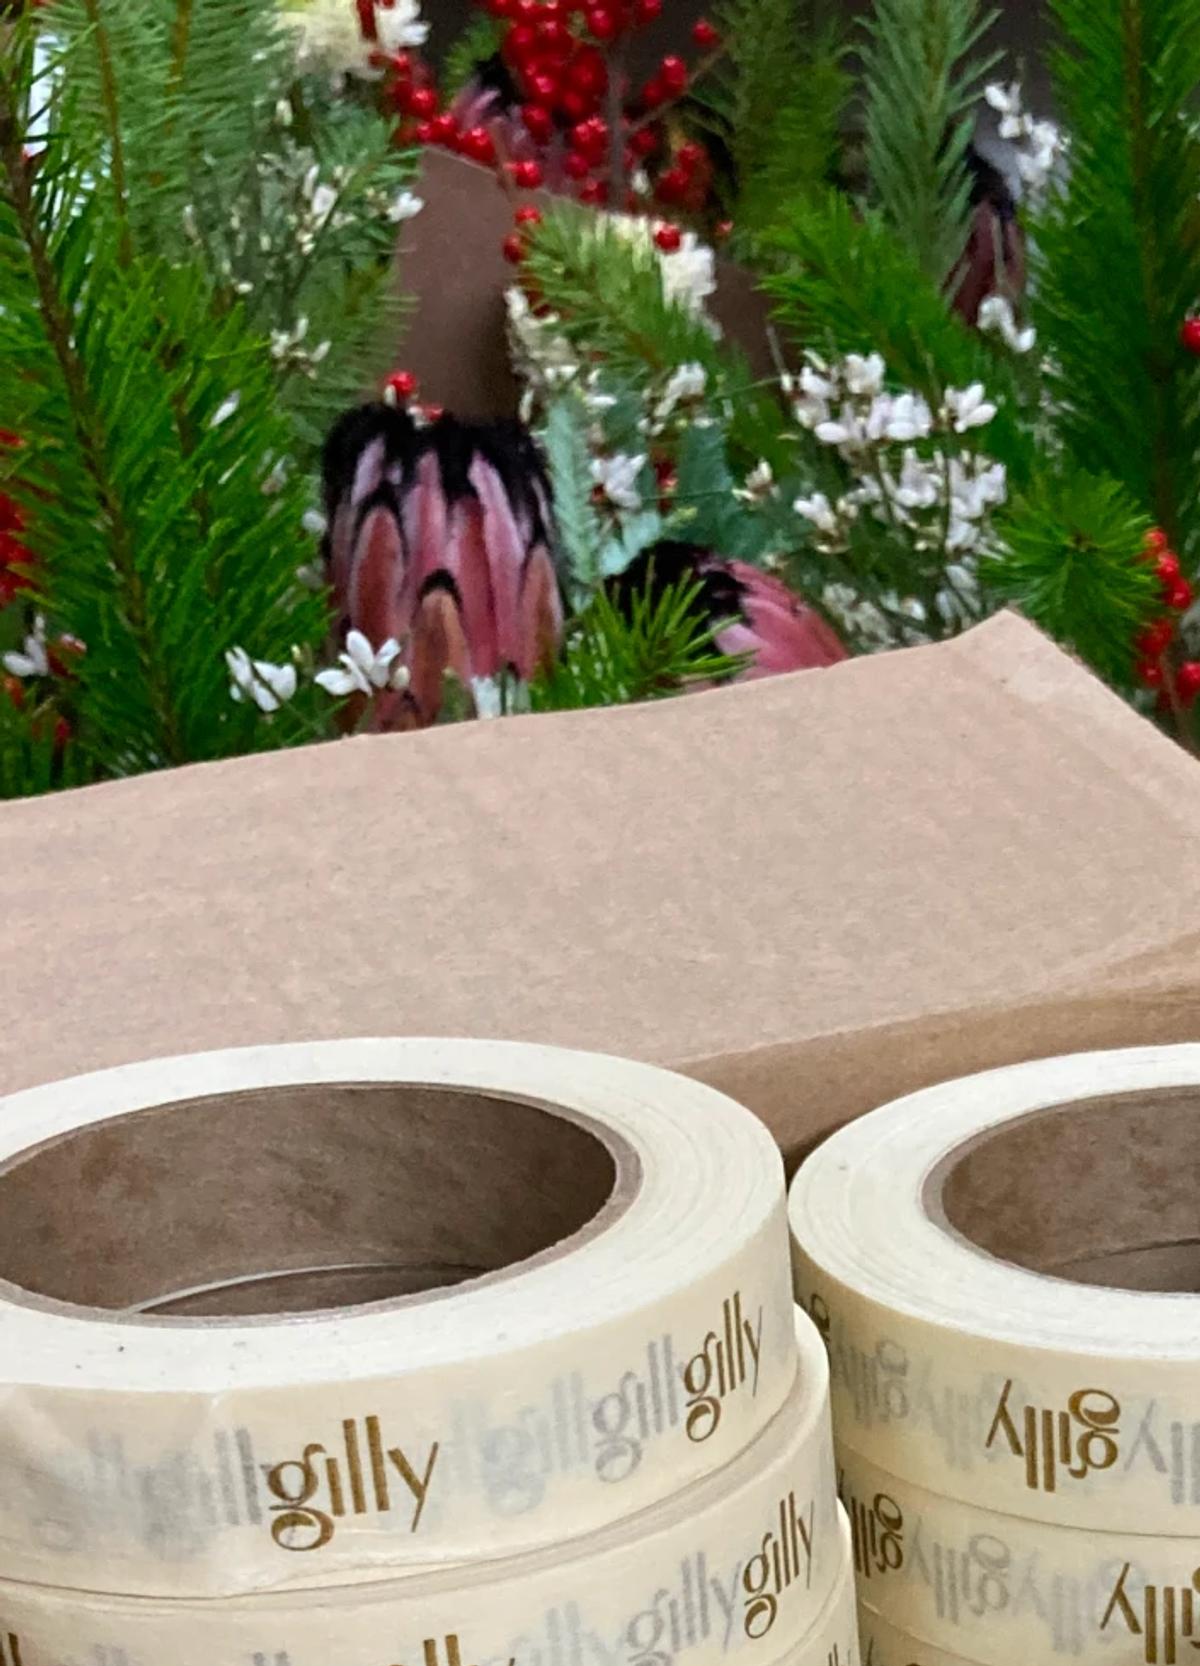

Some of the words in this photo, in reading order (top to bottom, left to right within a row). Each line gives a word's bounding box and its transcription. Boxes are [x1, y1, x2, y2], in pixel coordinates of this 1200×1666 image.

[684, 1291, 763, 1443] gilly
[985, 1378, 1120, 1492] gilly
[267, 1414, 439, 1551] gilly
[743, 1492, 816, 1640] gilly
